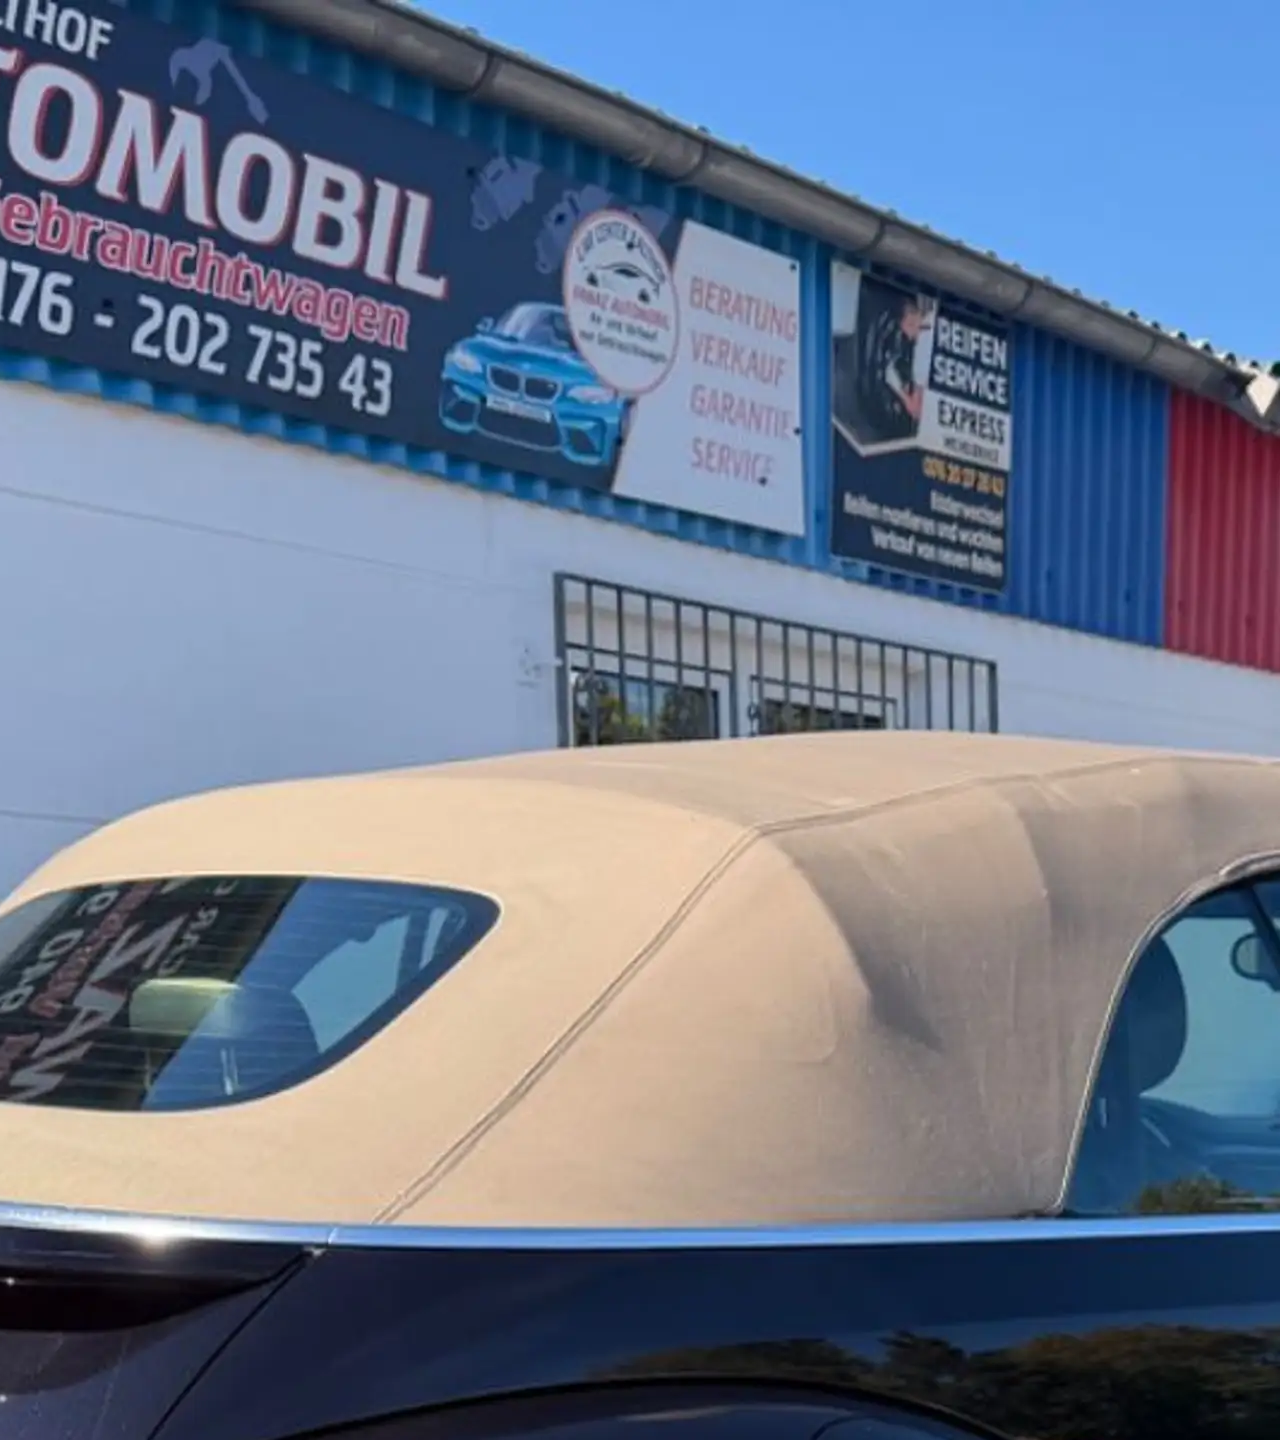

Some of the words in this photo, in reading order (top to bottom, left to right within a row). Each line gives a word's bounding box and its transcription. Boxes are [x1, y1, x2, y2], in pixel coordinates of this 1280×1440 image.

[689, 275, 798, 343] BERATUNG
[131, 294, 231, 376] 202
[245, 323, 325, 399] 735
[338, 352, 394, 418] 43
[689, 328, 787, 387] VERKAUF
[936, 315, 1008, 371] REIFEN
[932, 352, 1009, 406] SERVICE
[689, 383, 790, 440] GARANTIE
[937, 399, 1006, 446] EXPRESS
[690, 436, 774, 485] SERVICE
